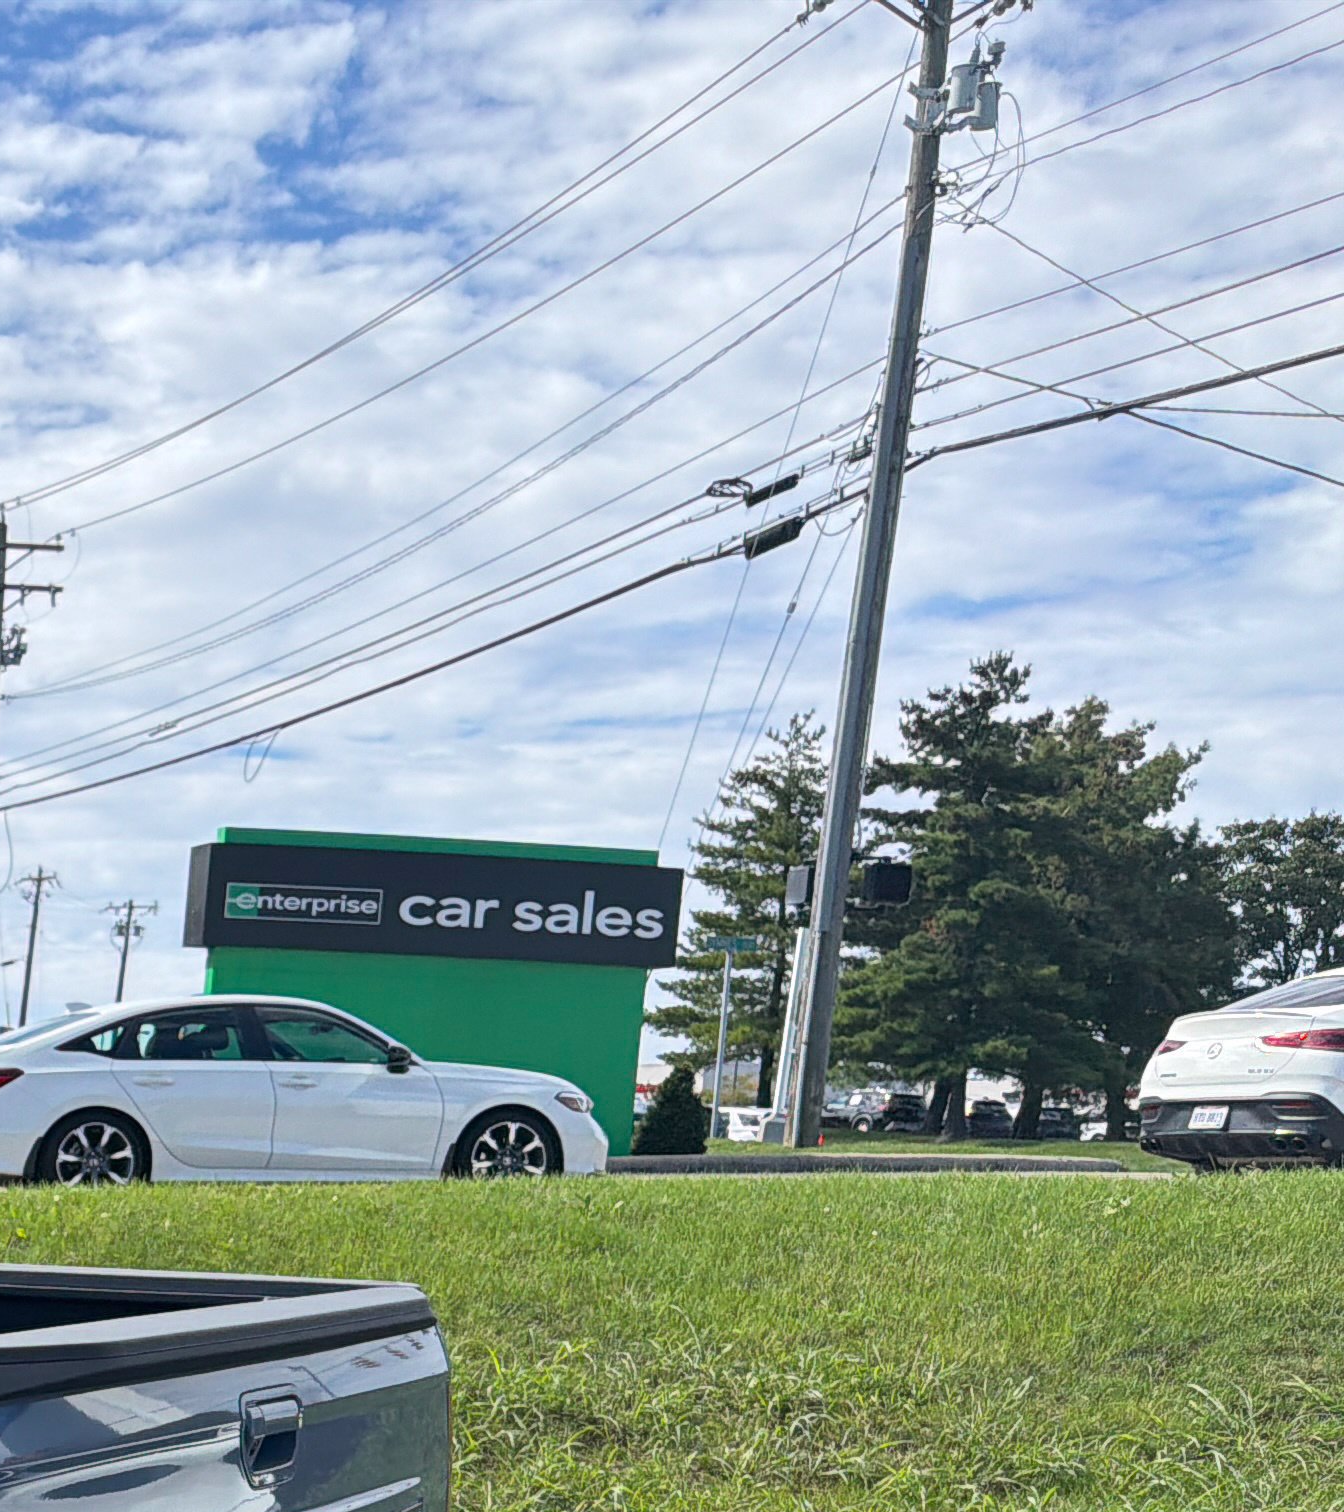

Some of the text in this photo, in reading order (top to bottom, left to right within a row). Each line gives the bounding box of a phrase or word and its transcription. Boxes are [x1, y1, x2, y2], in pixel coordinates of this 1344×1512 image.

[233, 890, 665, 940] enterprise car sales
